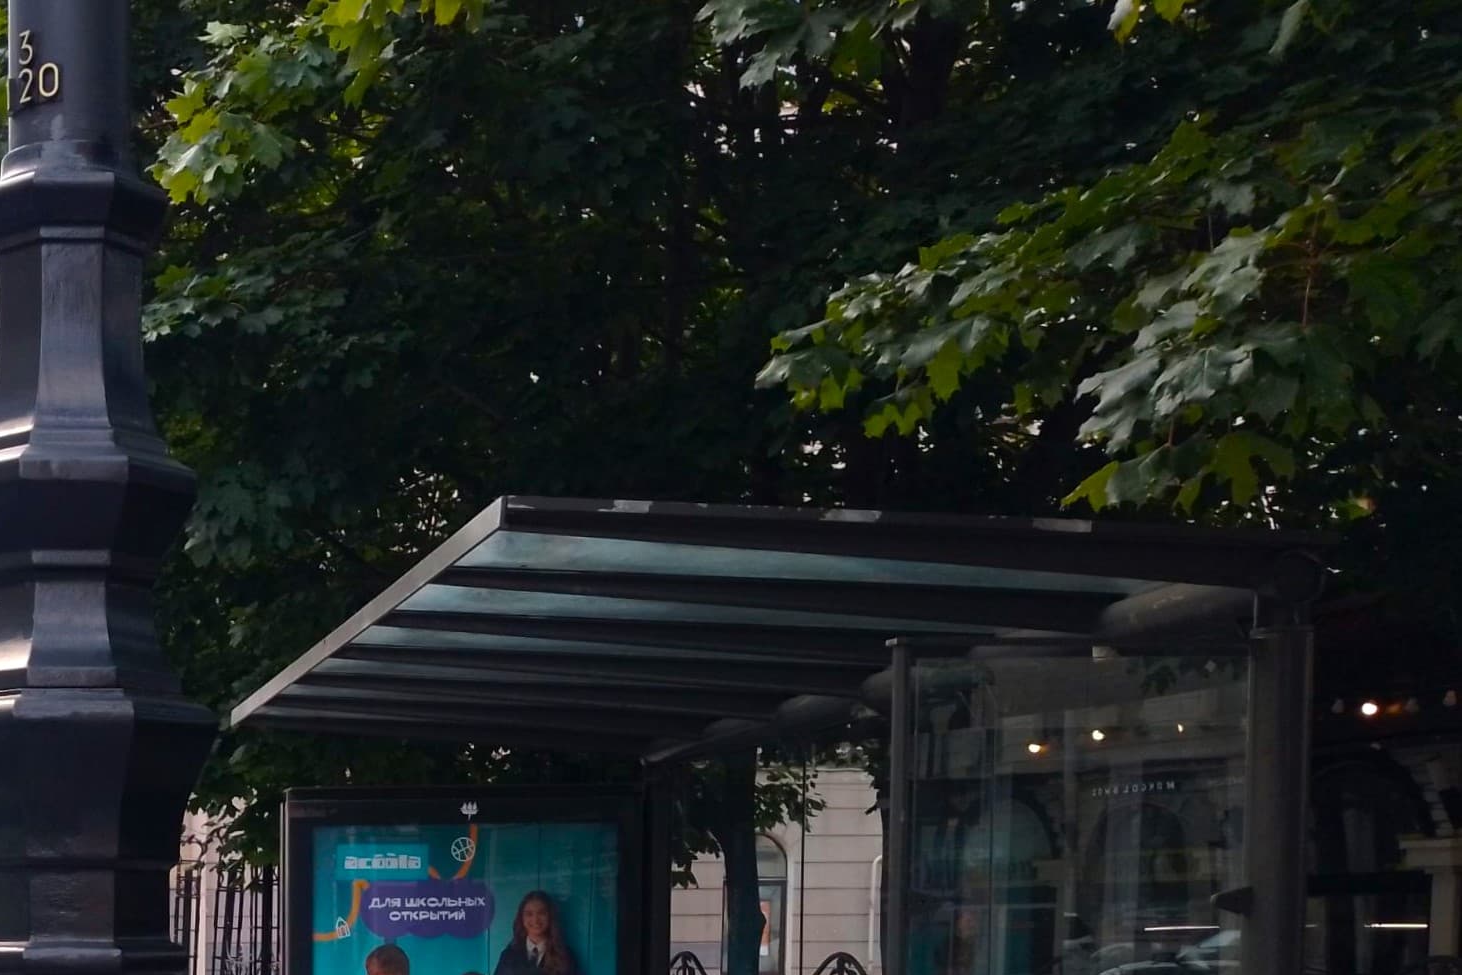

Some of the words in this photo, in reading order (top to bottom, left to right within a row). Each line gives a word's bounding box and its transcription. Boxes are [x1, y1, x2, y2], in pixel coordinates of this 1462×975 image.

[18, 29, 34, 66] 3
[18, 62, 60, 105] 20
[368, 896, 402, 910] ДЛЯ
[404, 896, 486, 909] ШКОЛЬНЫХ
[389, 909, 467, 922] ОТКРЫТИЙ
